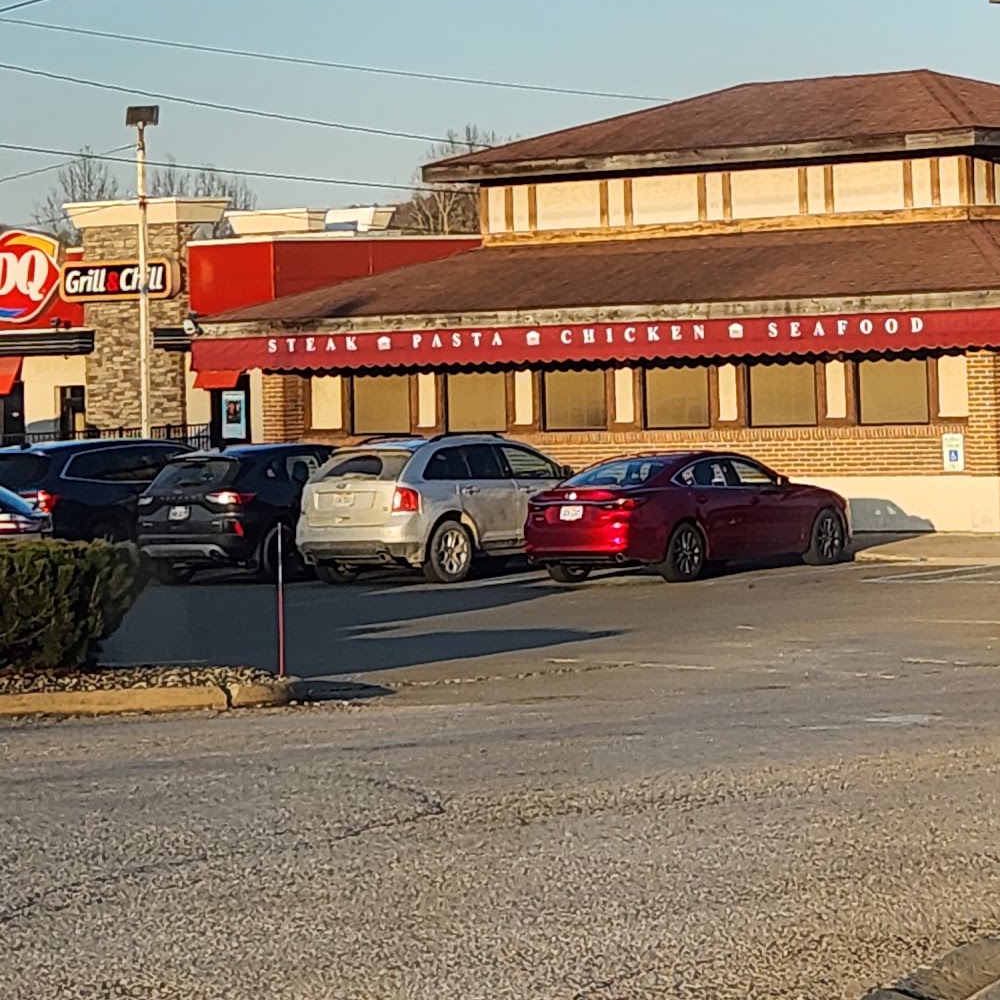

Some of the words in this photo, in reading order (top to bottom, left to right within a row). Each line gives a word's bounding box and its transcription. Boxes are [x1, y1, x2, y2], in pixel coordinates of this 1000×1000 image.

[120, 265, 164, 292] Chll
[560, 323, 706, 345] CHICKEN
[767, 316, 925, 338] SEAFOOD
[267, 336, 358, 353] STEAK
[412, 331, 503, 349] PASTA
